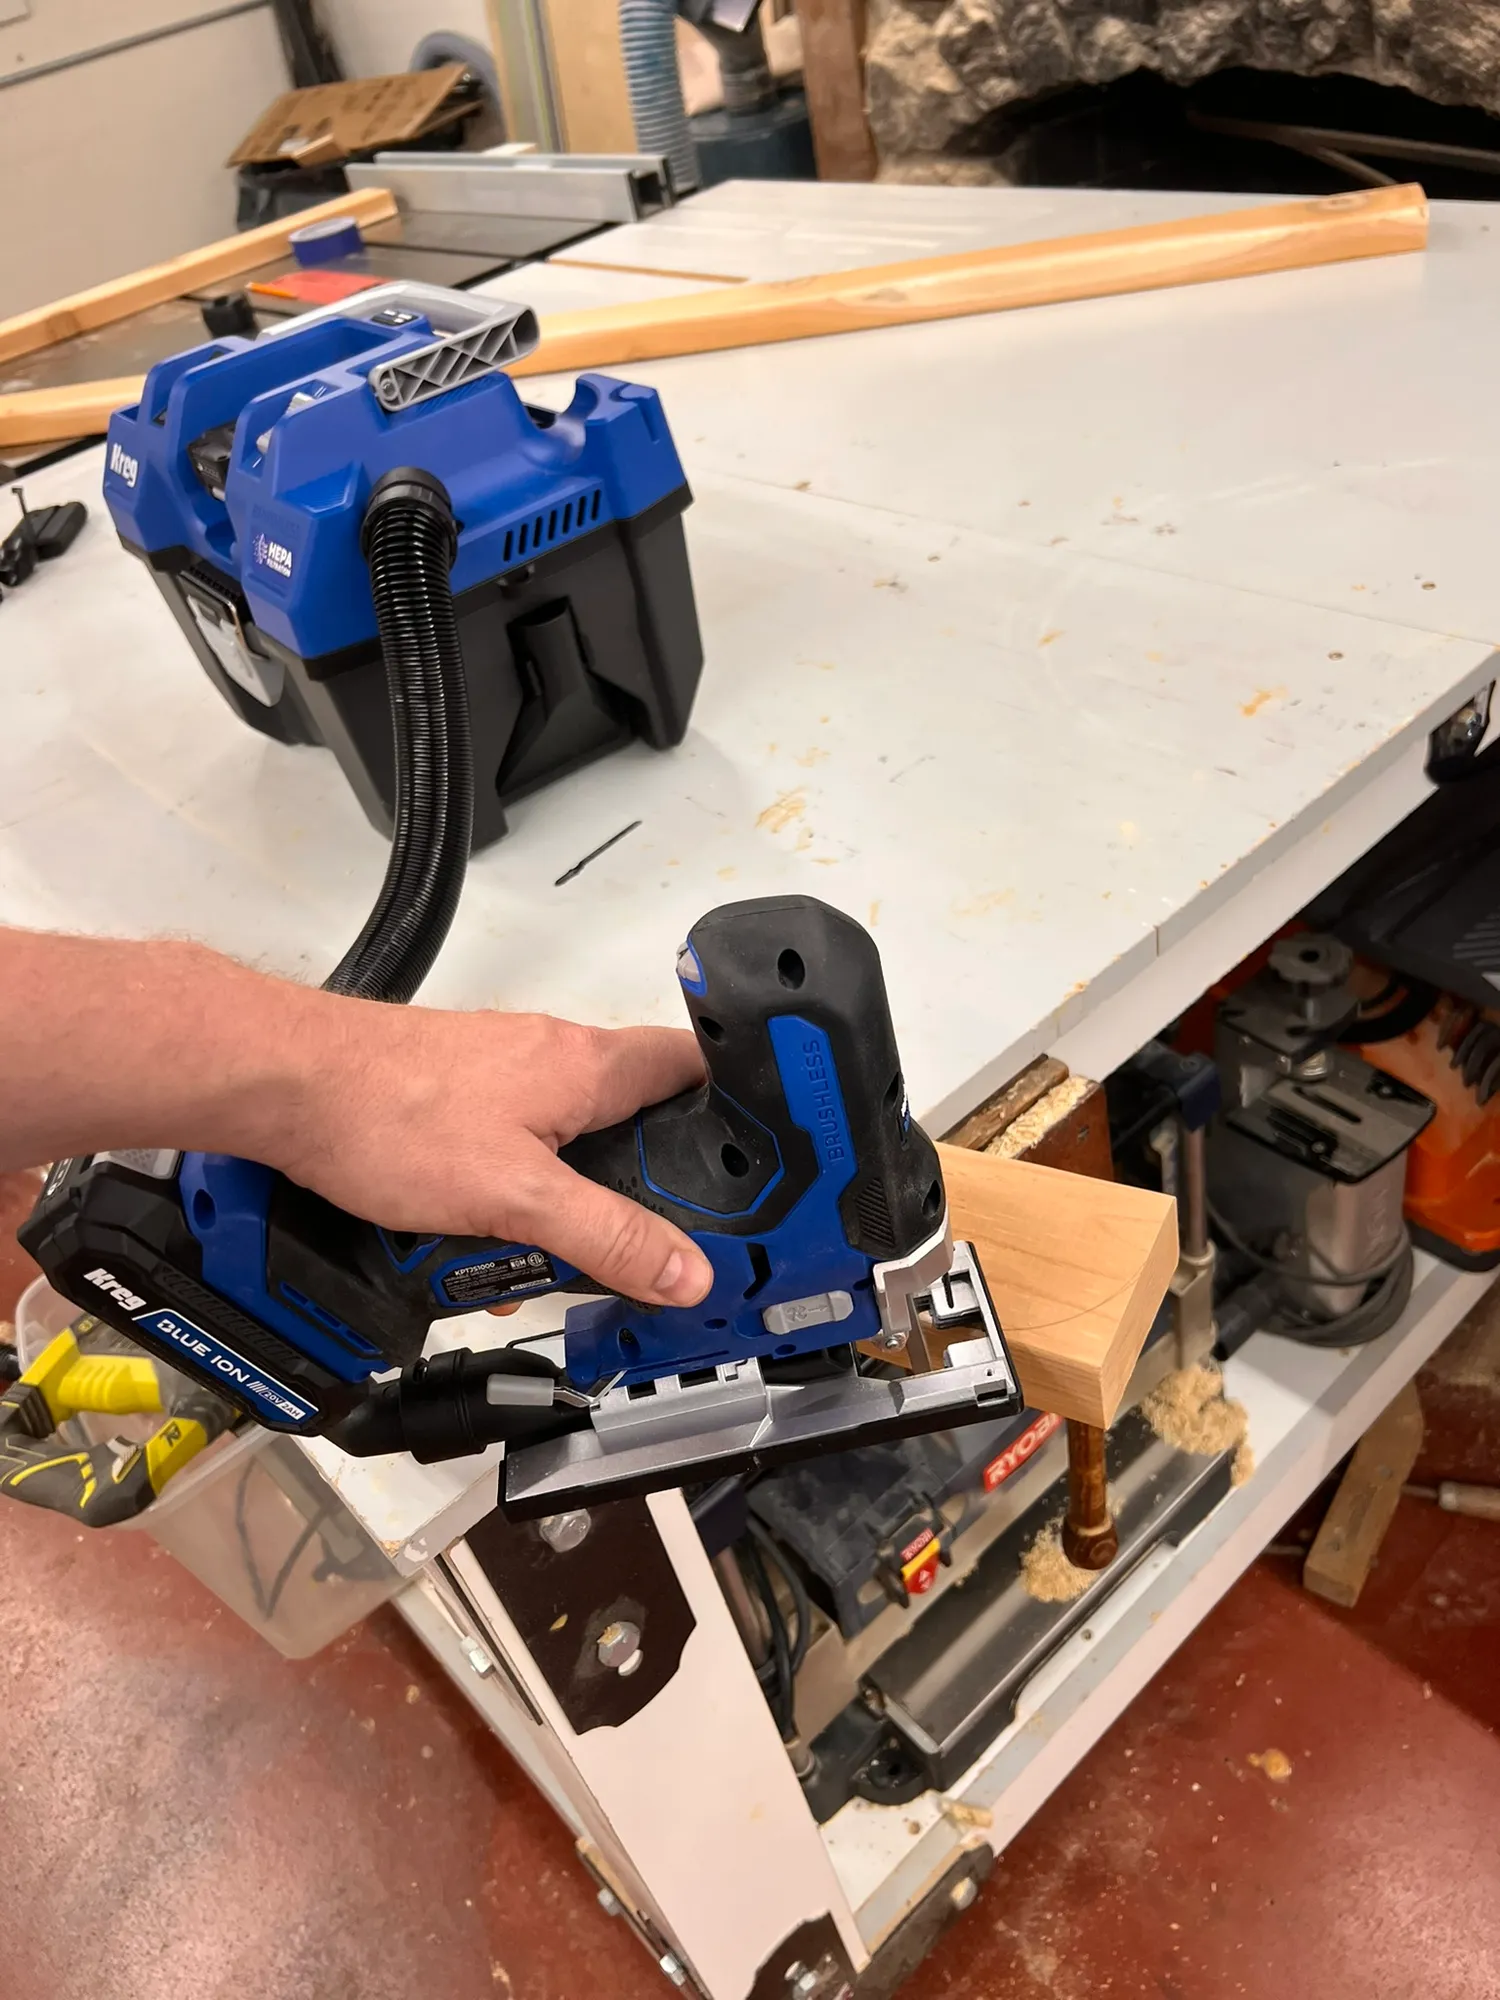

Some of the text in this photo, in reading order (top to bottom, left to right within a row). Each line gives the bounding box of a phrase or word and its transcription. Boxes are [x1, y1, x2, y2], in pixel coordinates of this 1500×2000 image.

[110, 442, 138, 488] Kreg
[268, 541, 292, 569] HEPA
[802, 1039, 845, 1162] BRUSHLESS
[83, 1267, 147, 1311] Kreg
[454, 1261, 496, 1276] KPTJS1000
[156, 1318, 251, 1383] BLUE ION
[264, 1391, 301, 1417] 20V 2AH
